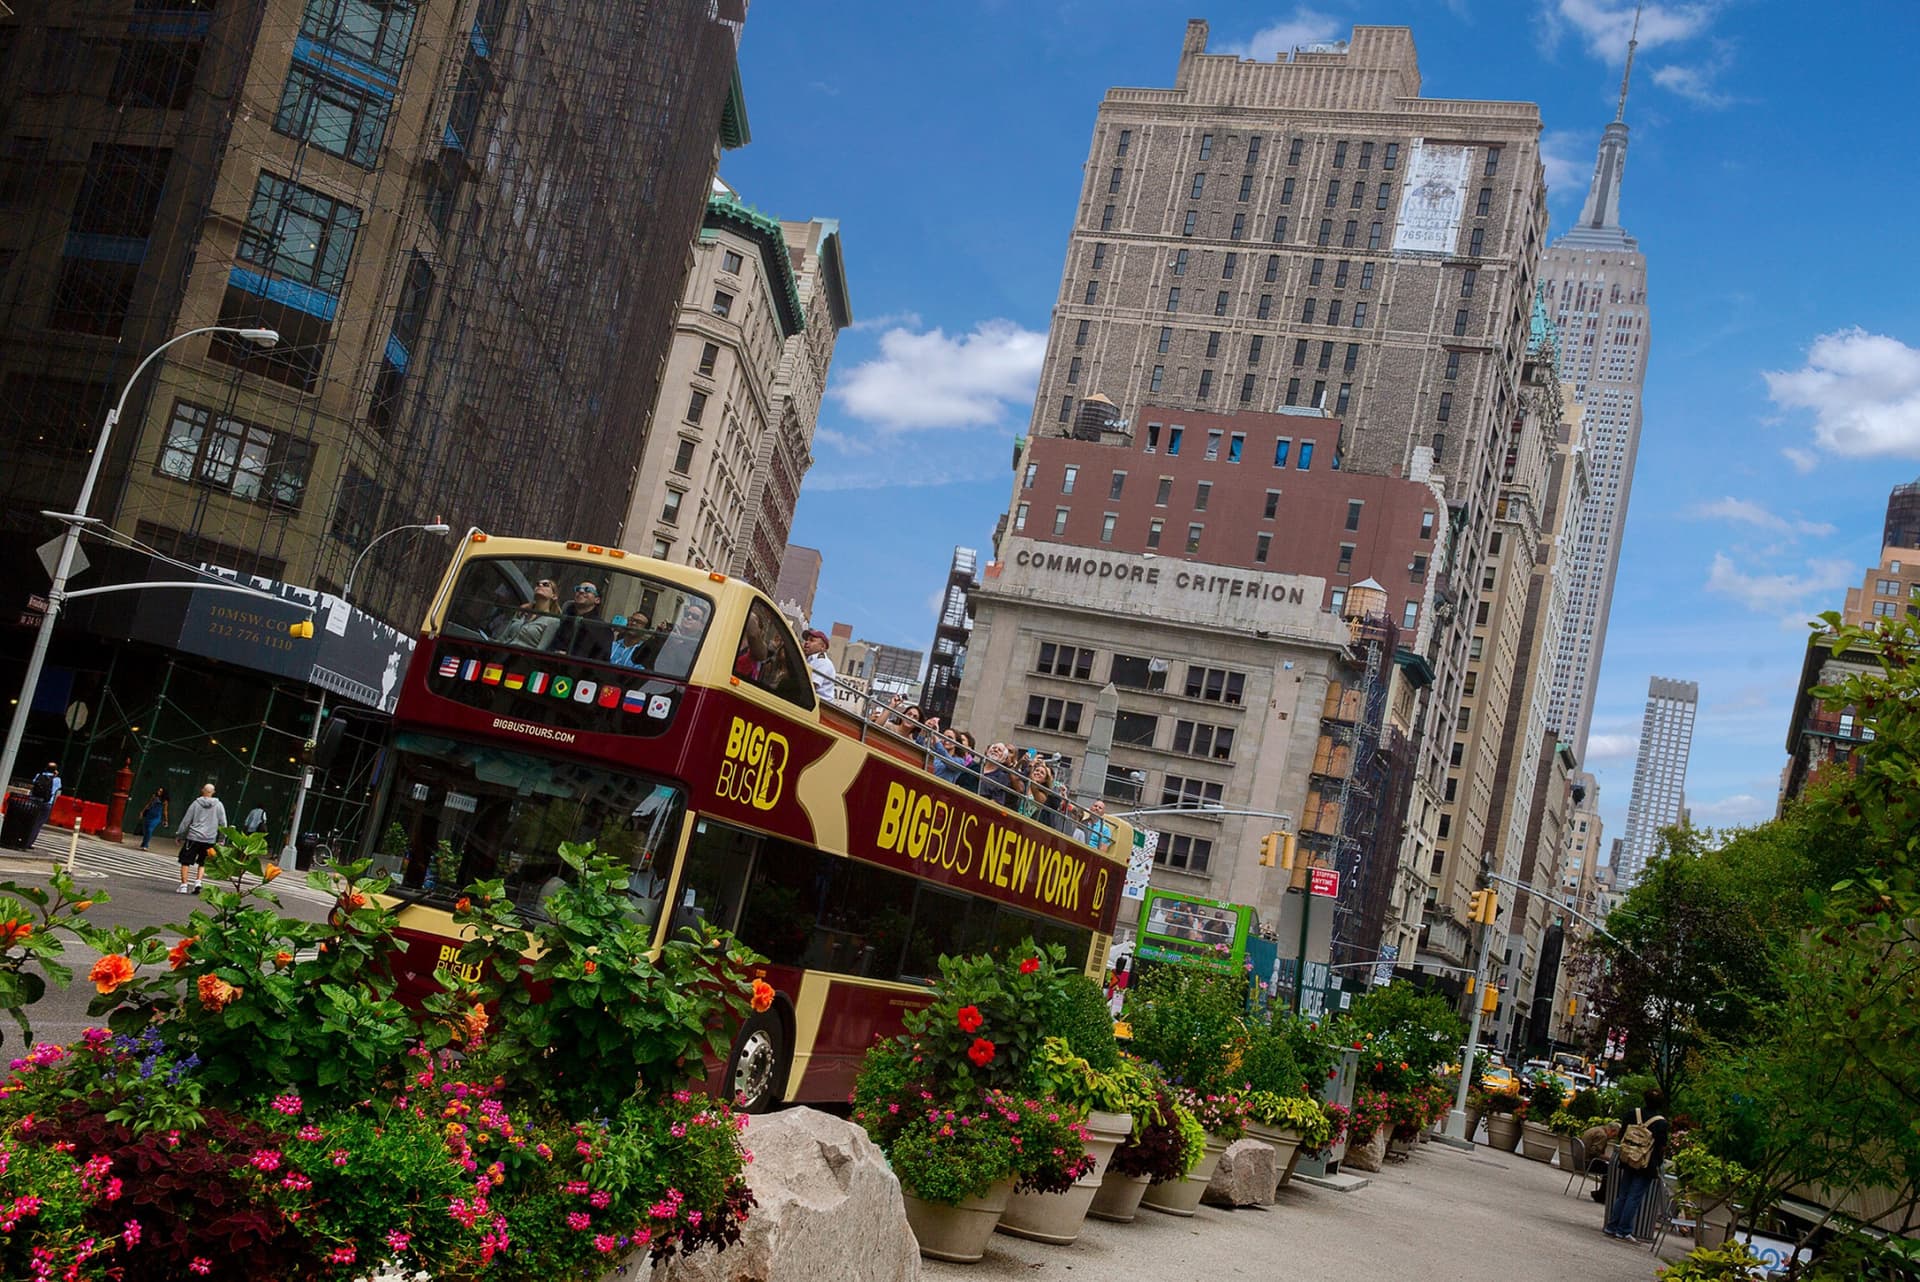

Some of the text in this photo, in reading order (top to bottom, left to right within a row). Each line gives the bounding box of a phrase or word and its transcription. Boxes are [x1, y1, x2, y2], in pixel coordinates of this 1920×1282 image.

[1017, 550, 1305, 605] COMMODORE CRITERION
[208, 622, 293, 651] 212 776 1110
[209, 606, 289, 633] 10MSW.CO
[492, 718, 576, 744] BIGBUSTOURS.COM
[725, 716, 766, 766] BIG
[715, 759, 756, 805] BUS
[979, 822, 1037, 894] NEW
[1034, 844, 1086, 912] YORK
